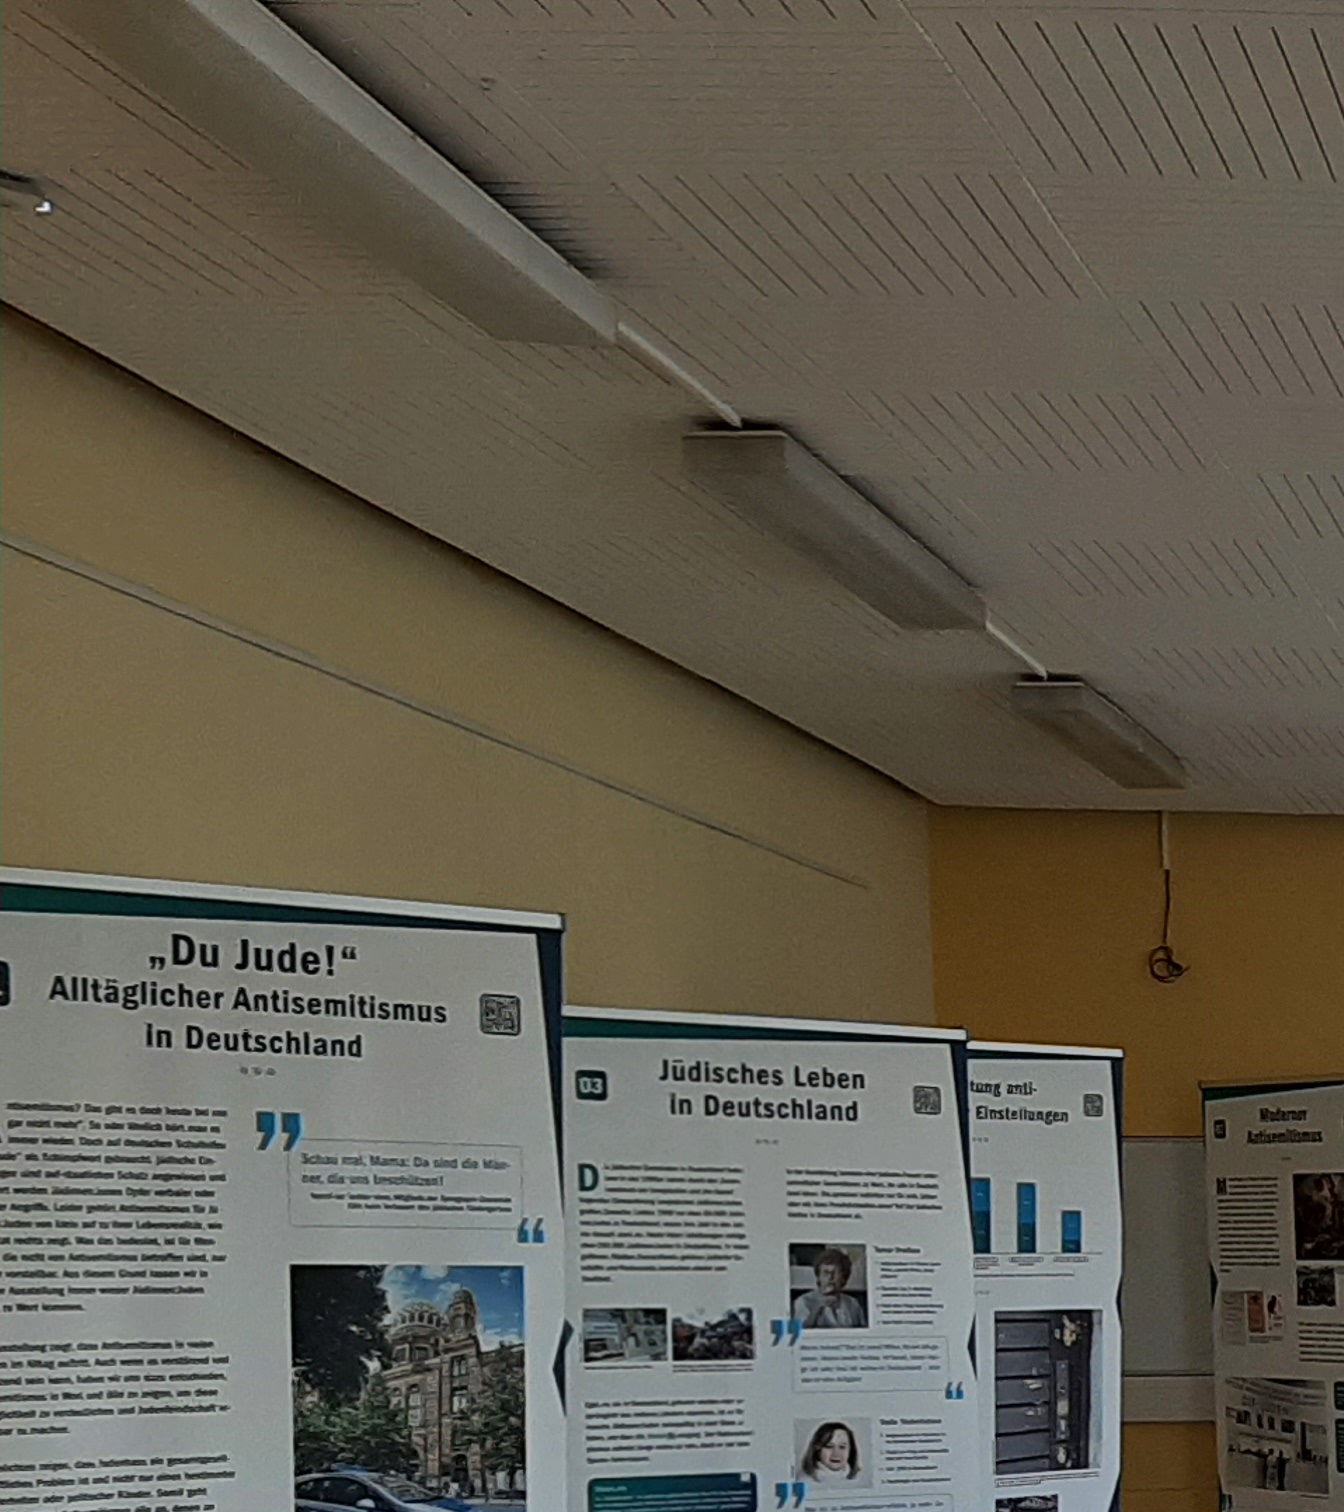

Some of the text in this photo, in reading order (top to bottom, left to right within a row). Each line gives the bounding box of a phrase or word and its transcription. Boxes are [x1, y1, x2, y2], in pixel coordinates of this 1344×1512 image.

[148, 933, 358, 977] „Du Jude!“
[48, 975, 448, 1024] Alltäglicher Antisemitismus
[145, 1022, 363, 1059] in Deutschland
[659, 1059, 866, 1089] Jüdisches Leben
[670, 1093, 859, 1122] in Deutschland
[976, 1105, 1069, 1126] Einstellungen
[577, 1163, 599, 1192] D
